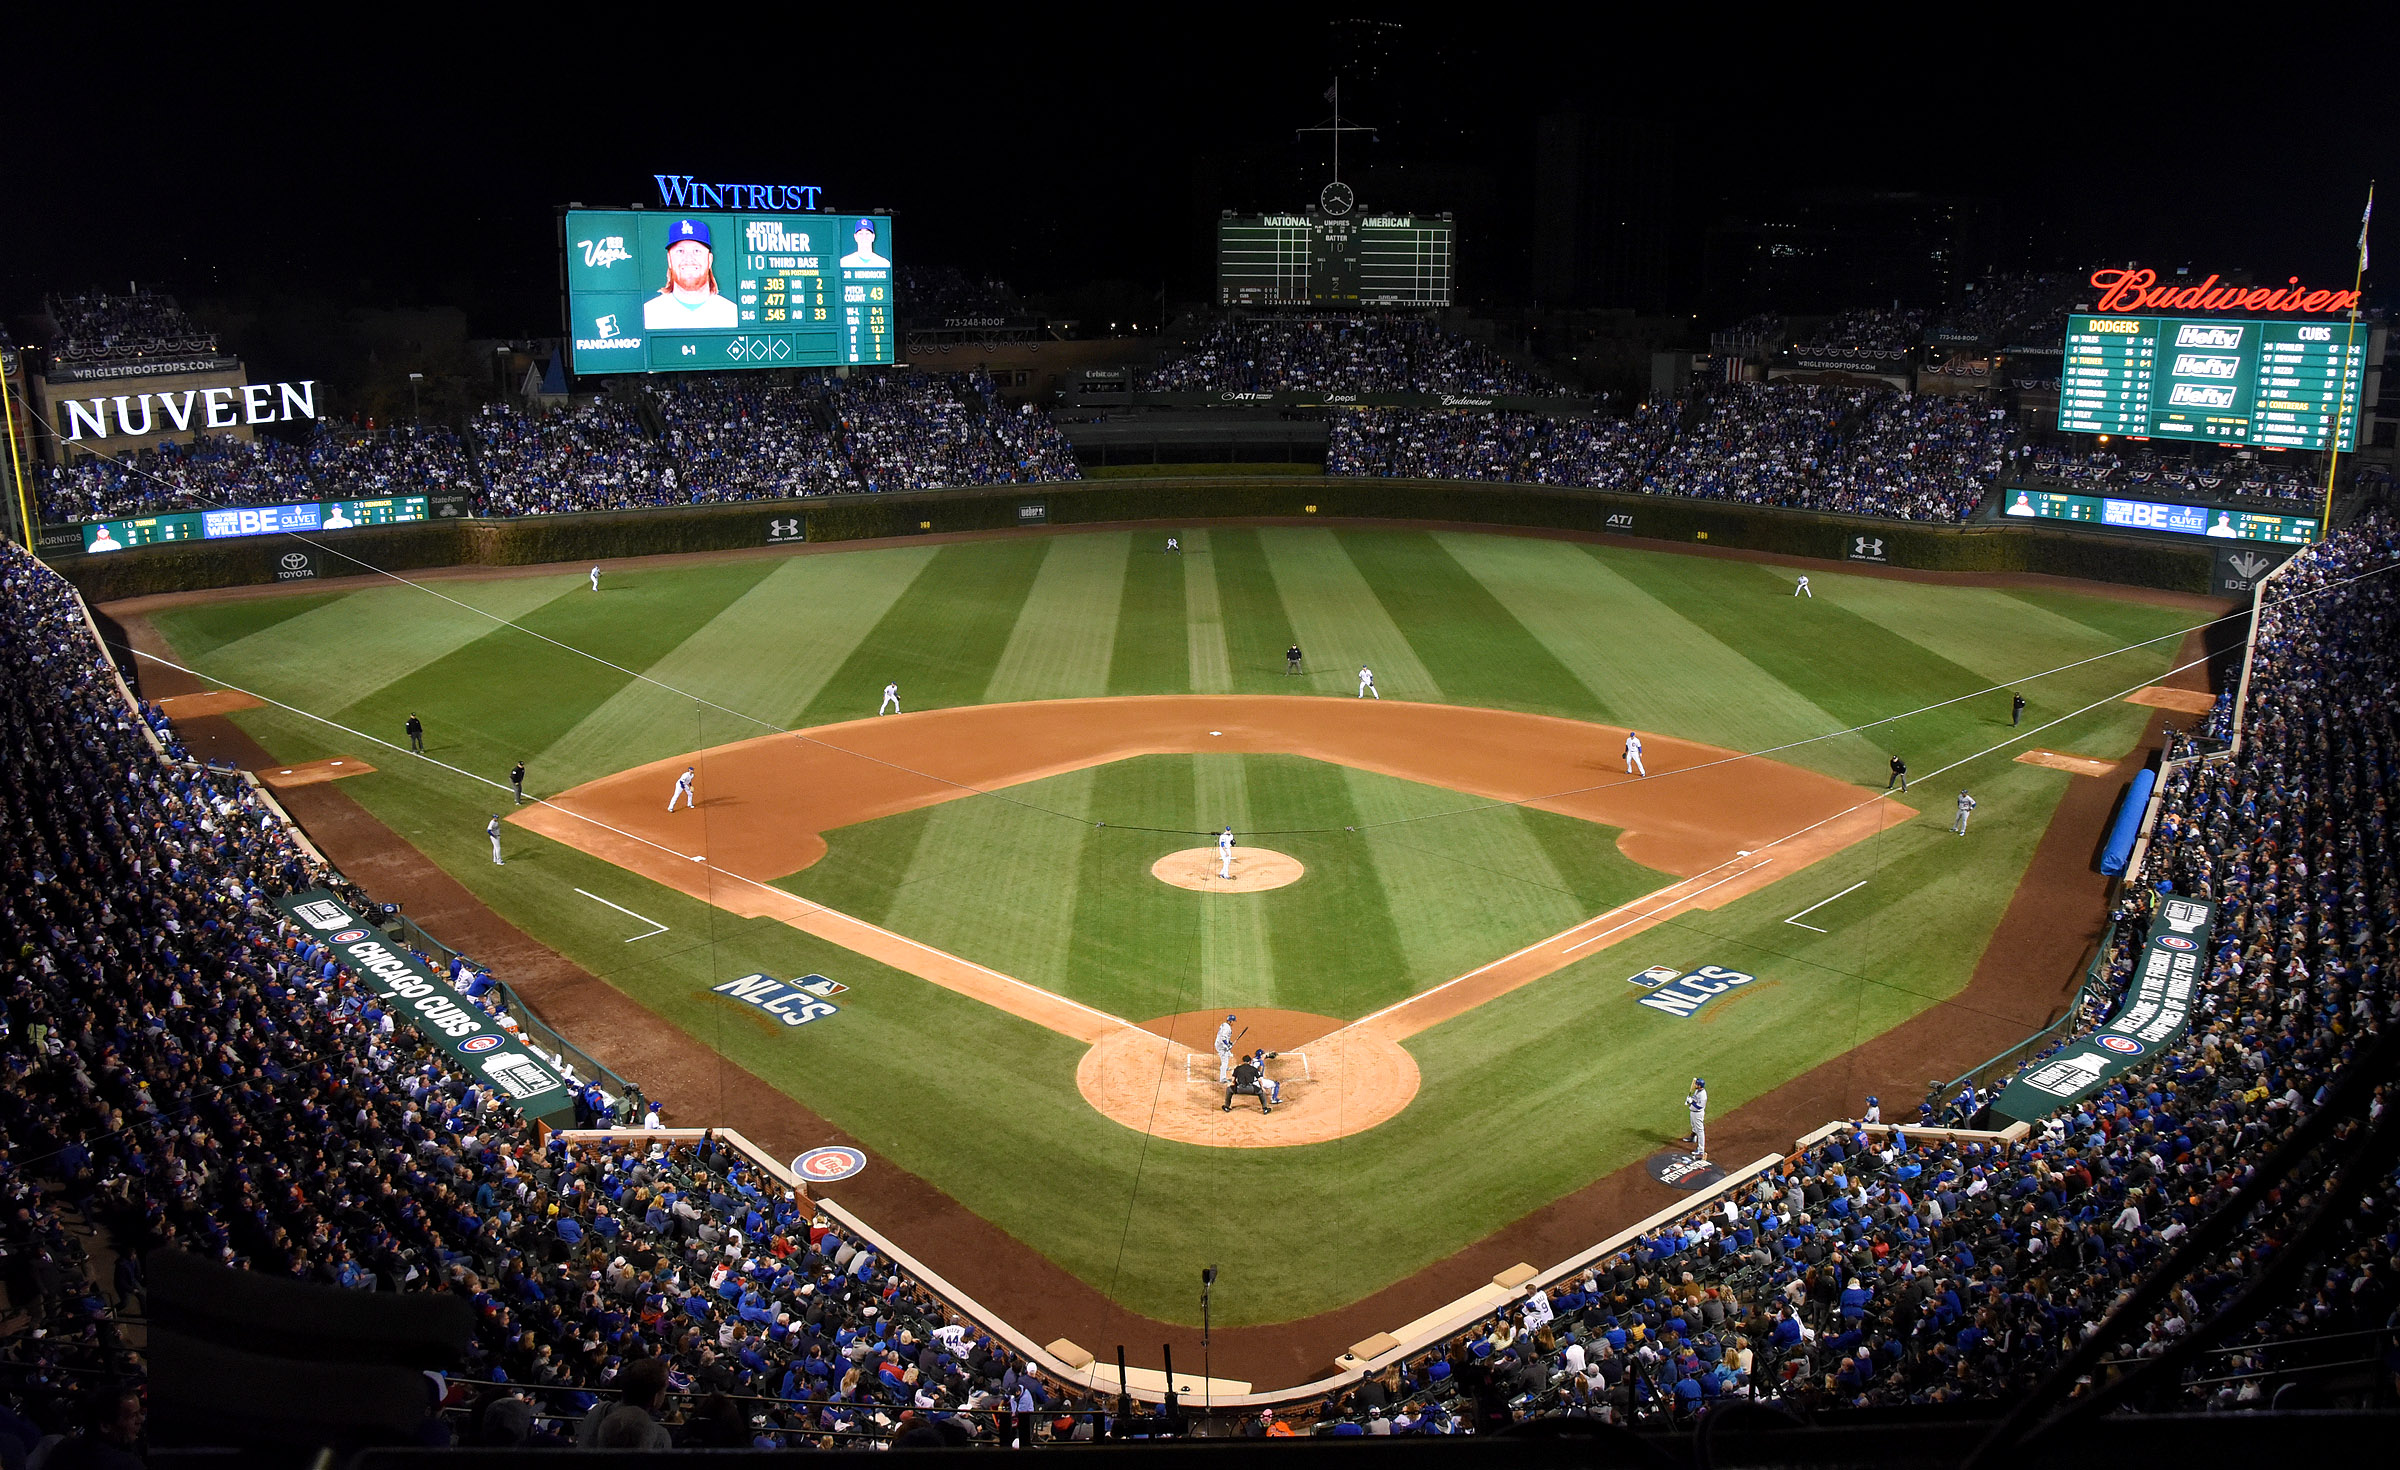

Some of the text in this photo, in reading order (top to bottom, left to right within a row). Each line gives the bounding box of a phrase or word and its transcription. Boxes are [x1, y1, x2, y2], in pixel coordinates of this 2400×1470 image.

[654, 175, 821, 210] WINTRUST
[746, 222, 783, 234] JUSTIN
[1264, 216, 1410, 228] NATIONAL AMERICAN
[746, 233, 810, 252] TURNER
[747, 255, 819, 270] 10 THIRD BASE
[855, 271, 886, 279] HENDRICKS
[740, 278, 823, 291] AVG .303 HR 2
[1332, 282, 1340, 292] 2
[2091, 268, 2362, 313] Budweiser
[741, 295, 757, 304] OBP
[764, 293, 785, 306] .477
[816, 293, 823, 305] 8
[844, 294, 866, 302] COUNT
[870, 287, 884, 300] 43
[741, 310, 756, 320] SLG
[765, 309, 786, 321] .545
[814, 309, 826, 320] 33
[872, 307, 882, 315] 0-1
[847, 316, 884, 325] ERA 2.13
[870, 325, 884, 334] 12.2
[2088, 320, 2331, 340] DODGERS CUBS
[2142, 337, 2154, 346] 1-2
[2180, 328, 2238, 346] Hefty
[576, 339, 641, 350] FANDANGO
[682, 345, 696, 356] 0-1
[2275, 343, 2304, 352] FOWLER
[2141, 348, 2152, 357] 0-2
[1798, 360, 1876, 371] WRIGLEYROOFTOPS.COM
[2079, 356, 2103, 365] TURNER
[2140, 359, 2151, 367] 0-1
[2177, 357, 2234, 376] Hefty
[73, 360, 215, 379] WRIGLEYROOFTOPS.COM
[1234, 392, 1256, 400] ATI
[1335, 394, 1357, 403] pepsi
[1440, 394, 1493, 406] Budweiser
[2174, 386, 2231, 406] Hefty
[2270, 390, 2288, 398] BAEZ
[64, 380, 316, 441] NUVEEN
[2269, 401, 2309, 411] CONTRERAS
[2206, 426, 2216, 434] 12
[2220, 427, 2230, 435] 31
[2235, 428, 2245, 436] 43
[2317, 438, 2323, 446] P
[239, 510, 280, 533] BE
[281, 514, 316, 524] OLIVET
[1606, 514, 1633, 525] ATI
[2133, 504, 2169, 528] BE
[2170, 516, 2204, 526] OLIVET
[135, 519, 156, 527] TURNER
[208, 526, 240, 536] WILL
[38, 533, 82, 546] HORNITOS
[278, 570, 314, 579] TOYOTA
[347, 942, 482, 1037] CHICAGO CUBS
[1640, 965, 1754, 1017] NLCS
[2110, 948, 2172, 1034] WELCOME TO THE FRIENDLY
[712, 973, 837, 1026] NLCS
[2137, 952, 2197, 1043] CONFINES OF WRIGLEY FIELD
[1660, 1160, 1712, 1184] POSTSEASON
[1541, 1302, 1548, 1314] 9
[946, 1335, 958, 1346] 44
